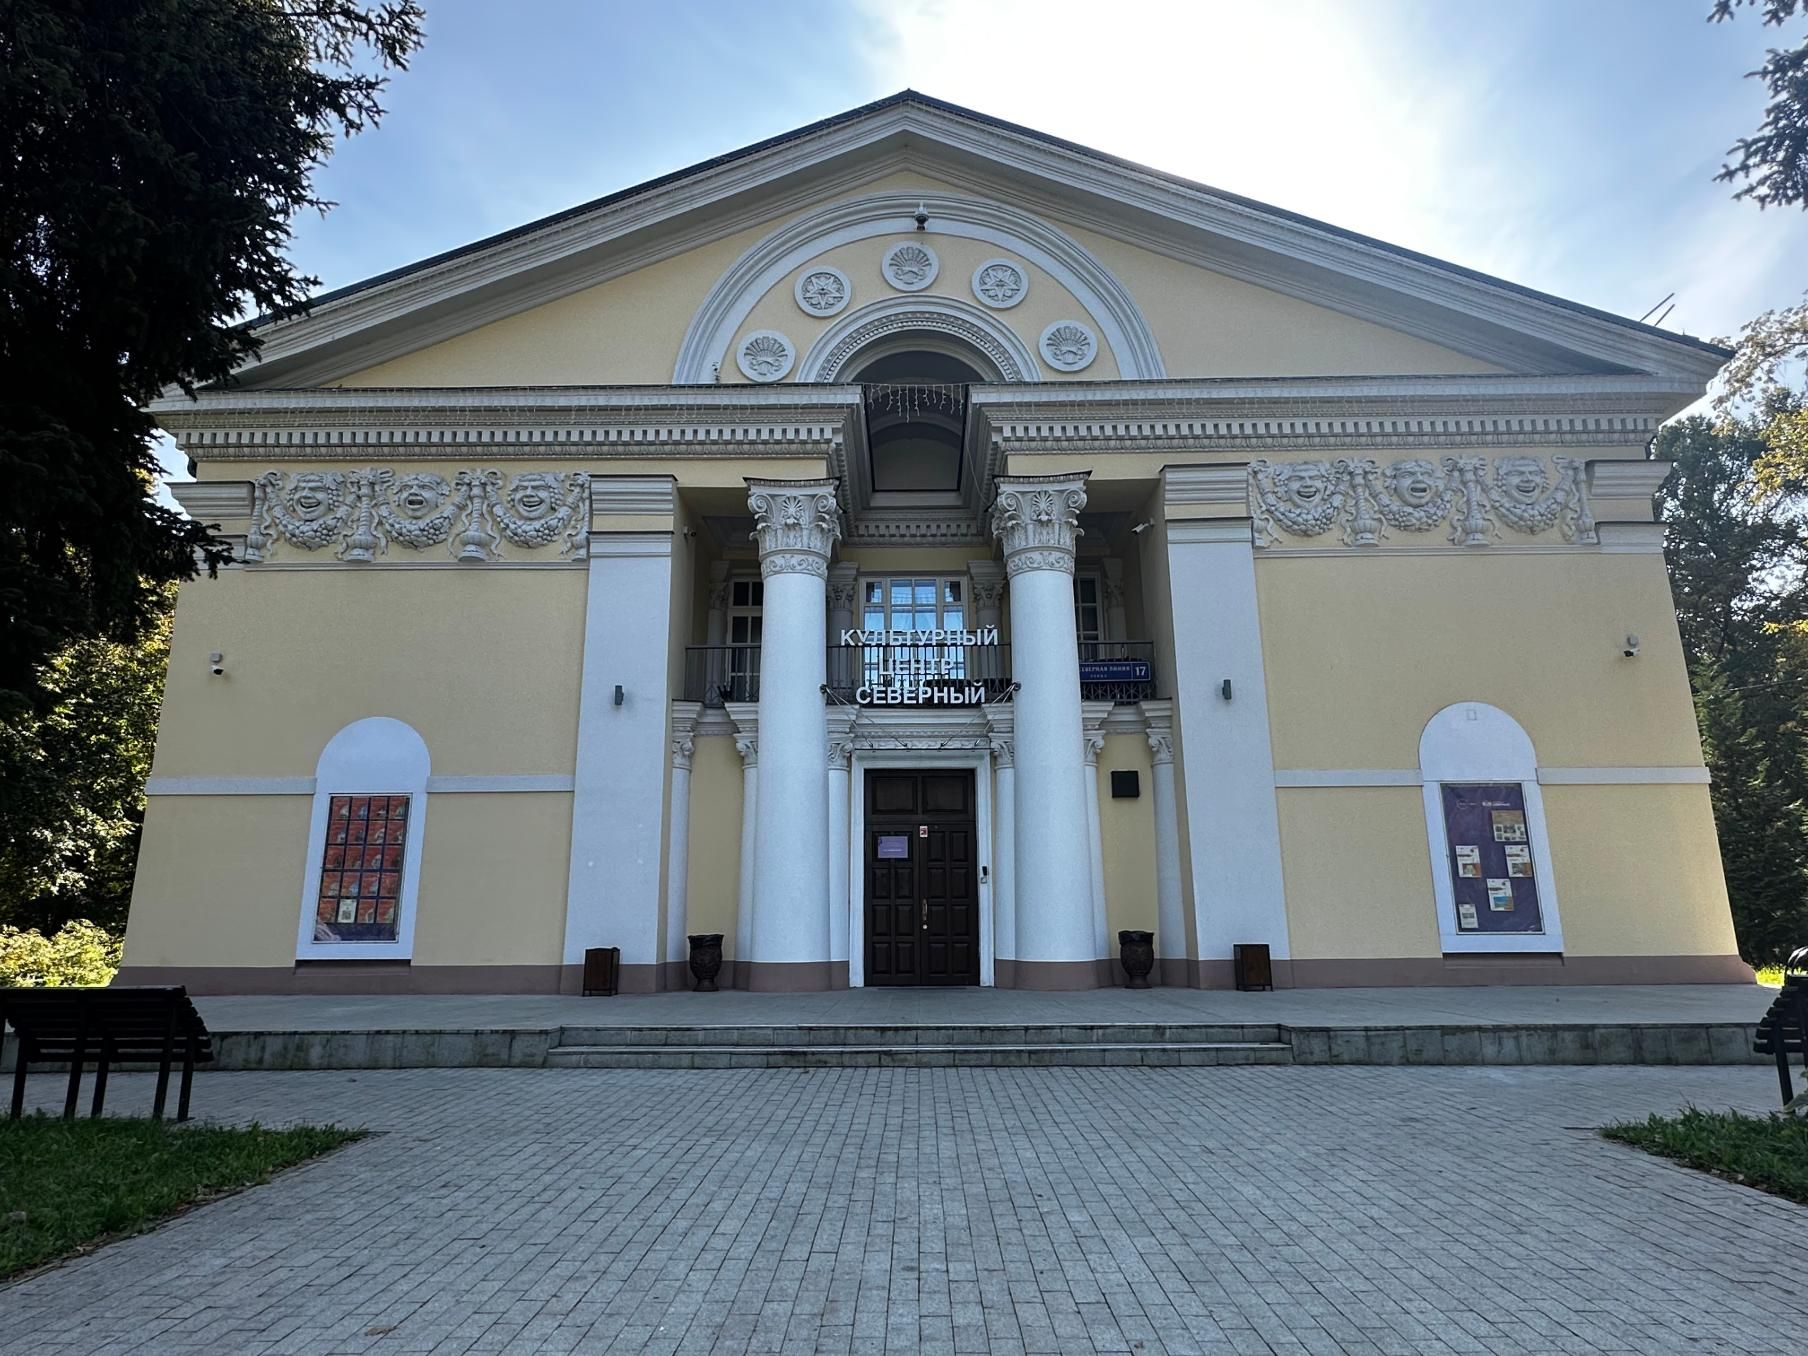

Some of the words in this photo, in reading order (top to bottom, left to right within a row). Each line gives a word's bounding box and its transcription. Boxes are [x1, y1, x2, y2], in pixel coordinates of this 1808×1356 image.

[840, 625, 998, 646] КУЛЬТУРНЫЙ
[879, 658, 954, 676] ЦЕНТР
[1135, 666, 1146, 676] 17
[855, 682, 985, 704] СЕВЕРНЫЙ
